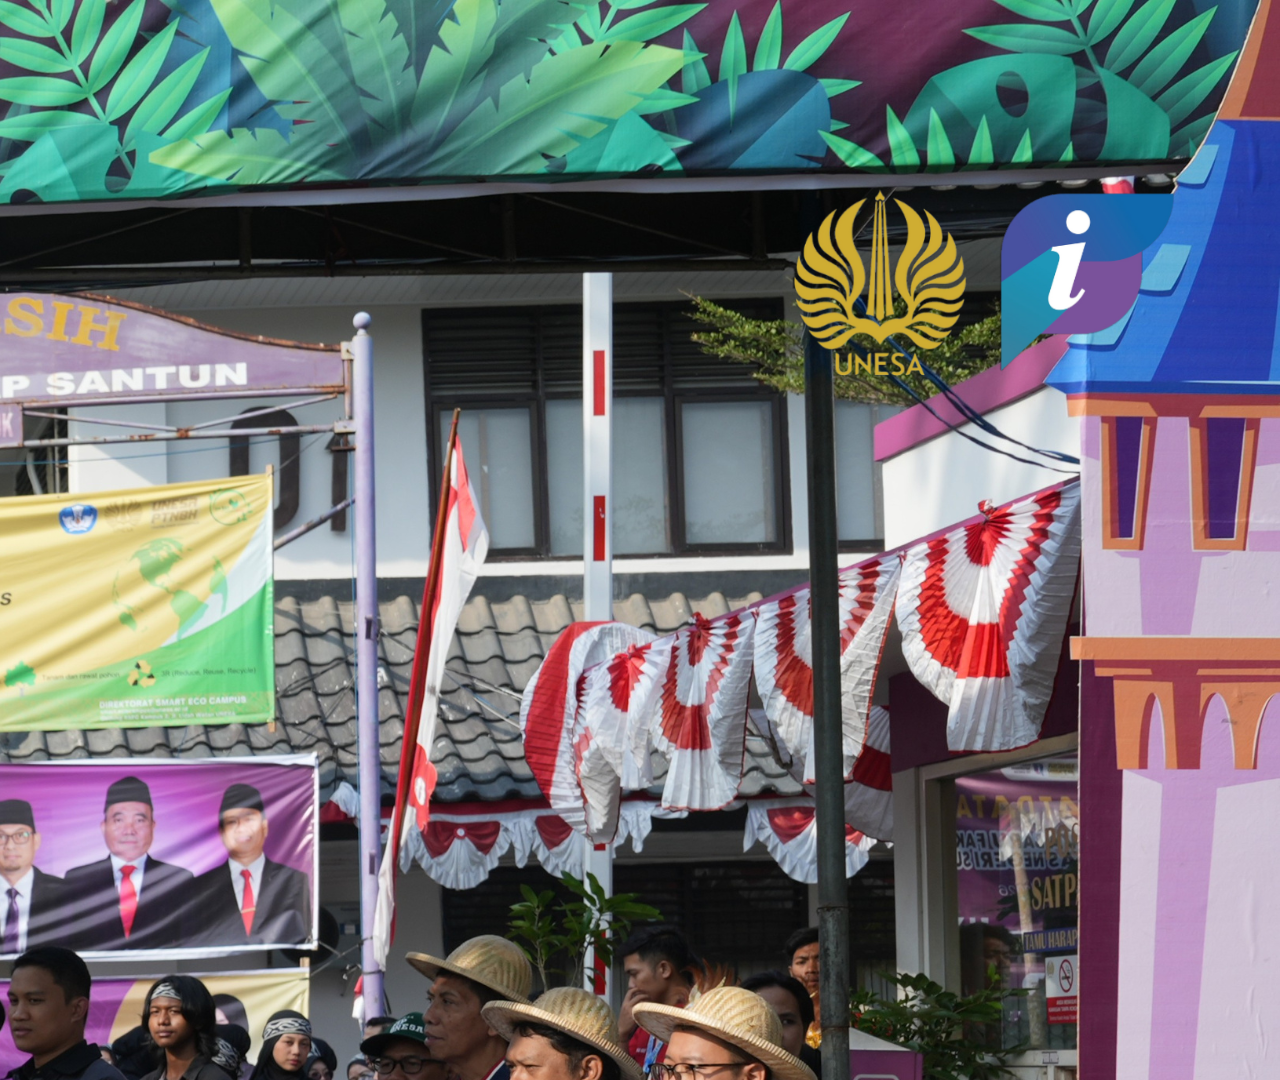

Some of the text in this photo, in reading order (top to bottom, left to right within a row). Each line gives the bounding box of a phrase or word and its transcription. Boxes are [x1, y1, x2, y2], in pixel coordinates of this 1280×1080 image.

[46, 362, 248, 396] SANTUN
[99, 696, 247, 709] DIREKTORAT SMART ECO CAMPUS
[1032, 873, 1078, 911] SATP
[1024, 933, 1047, 950] TAMU
